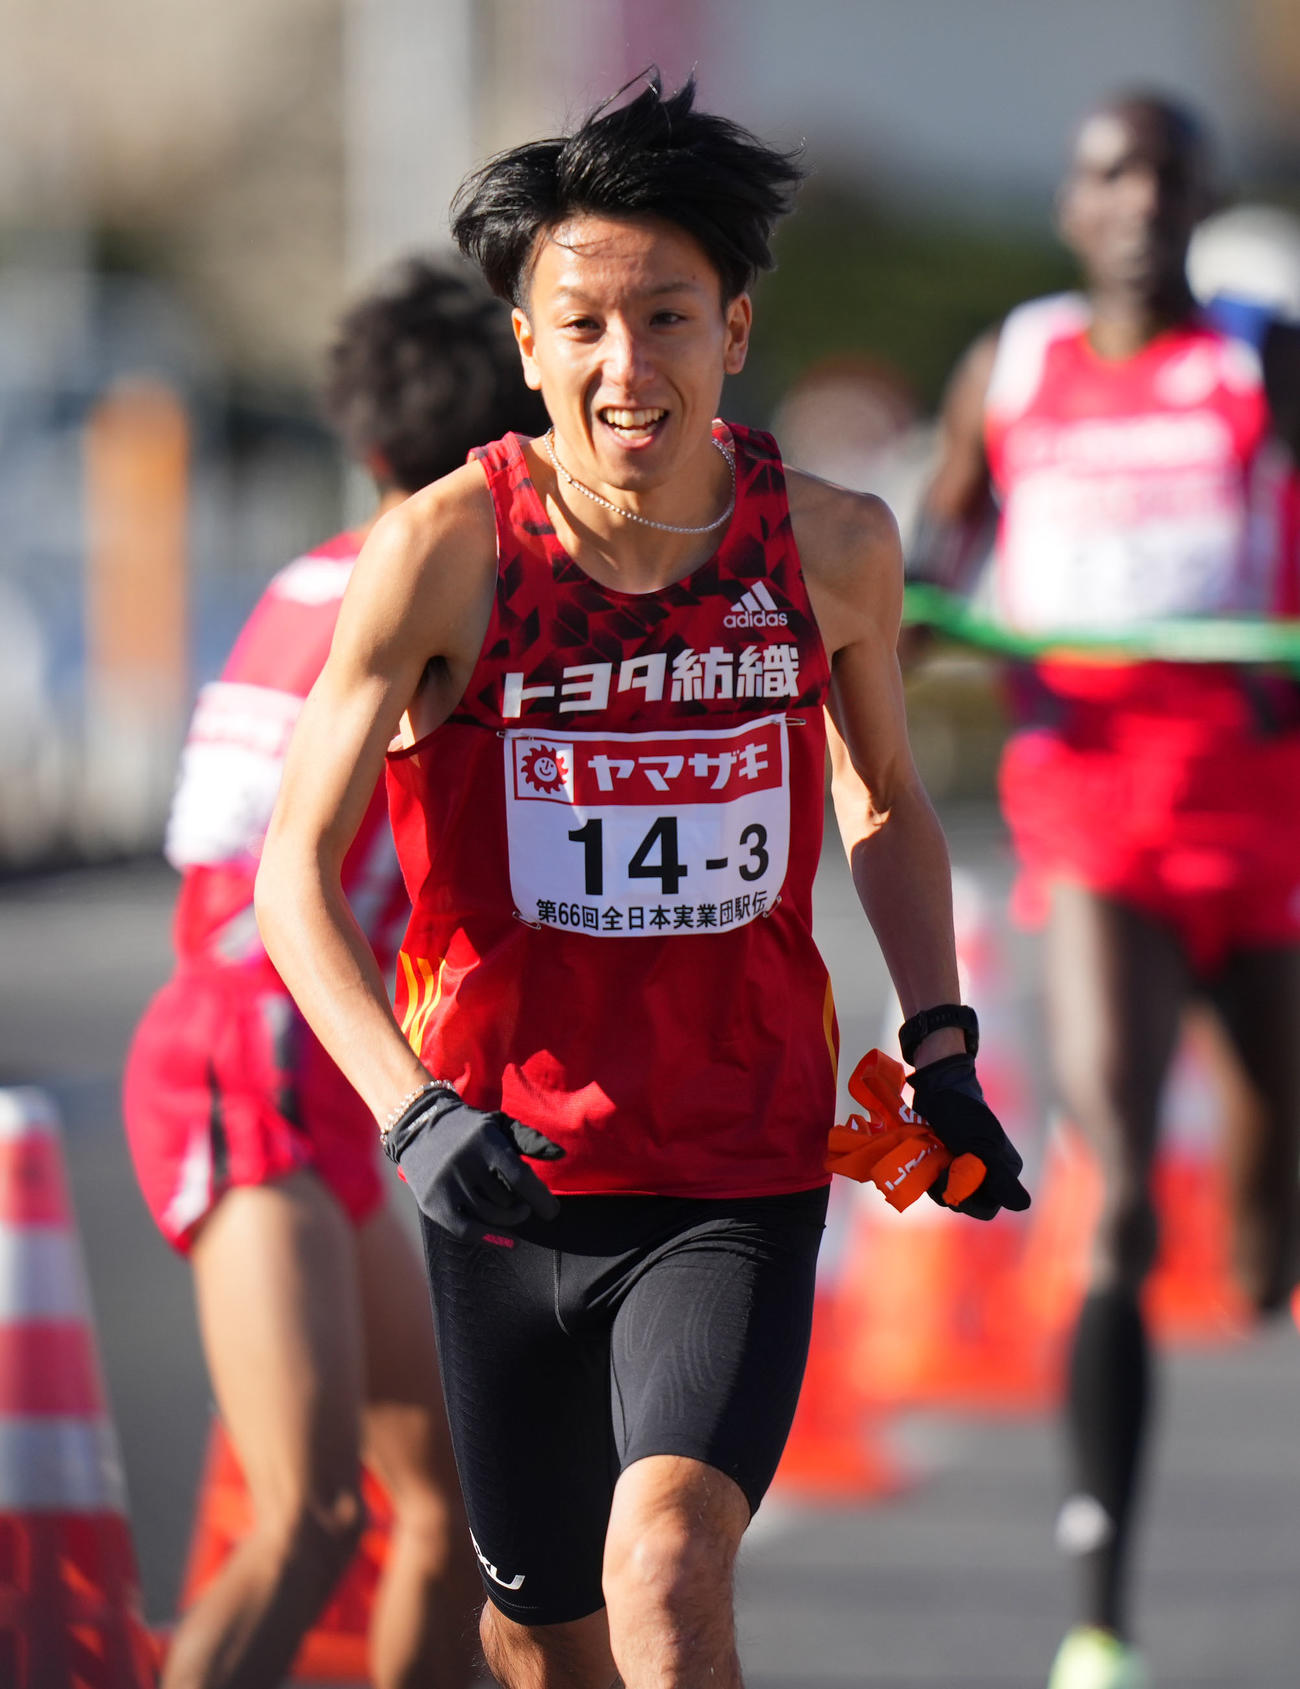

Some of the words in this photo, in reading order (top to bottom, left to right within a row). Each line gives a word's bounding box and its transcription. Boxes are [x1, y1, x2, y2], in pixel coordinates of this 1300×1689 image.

[723, 611, 788, 628] adidas
[502, 644, 800, 718] トヨタ紡織
[587, 743, 769, 792] ヤマザキ
[536, 891, 768, 930] 第66回全日本実業団駅伝
